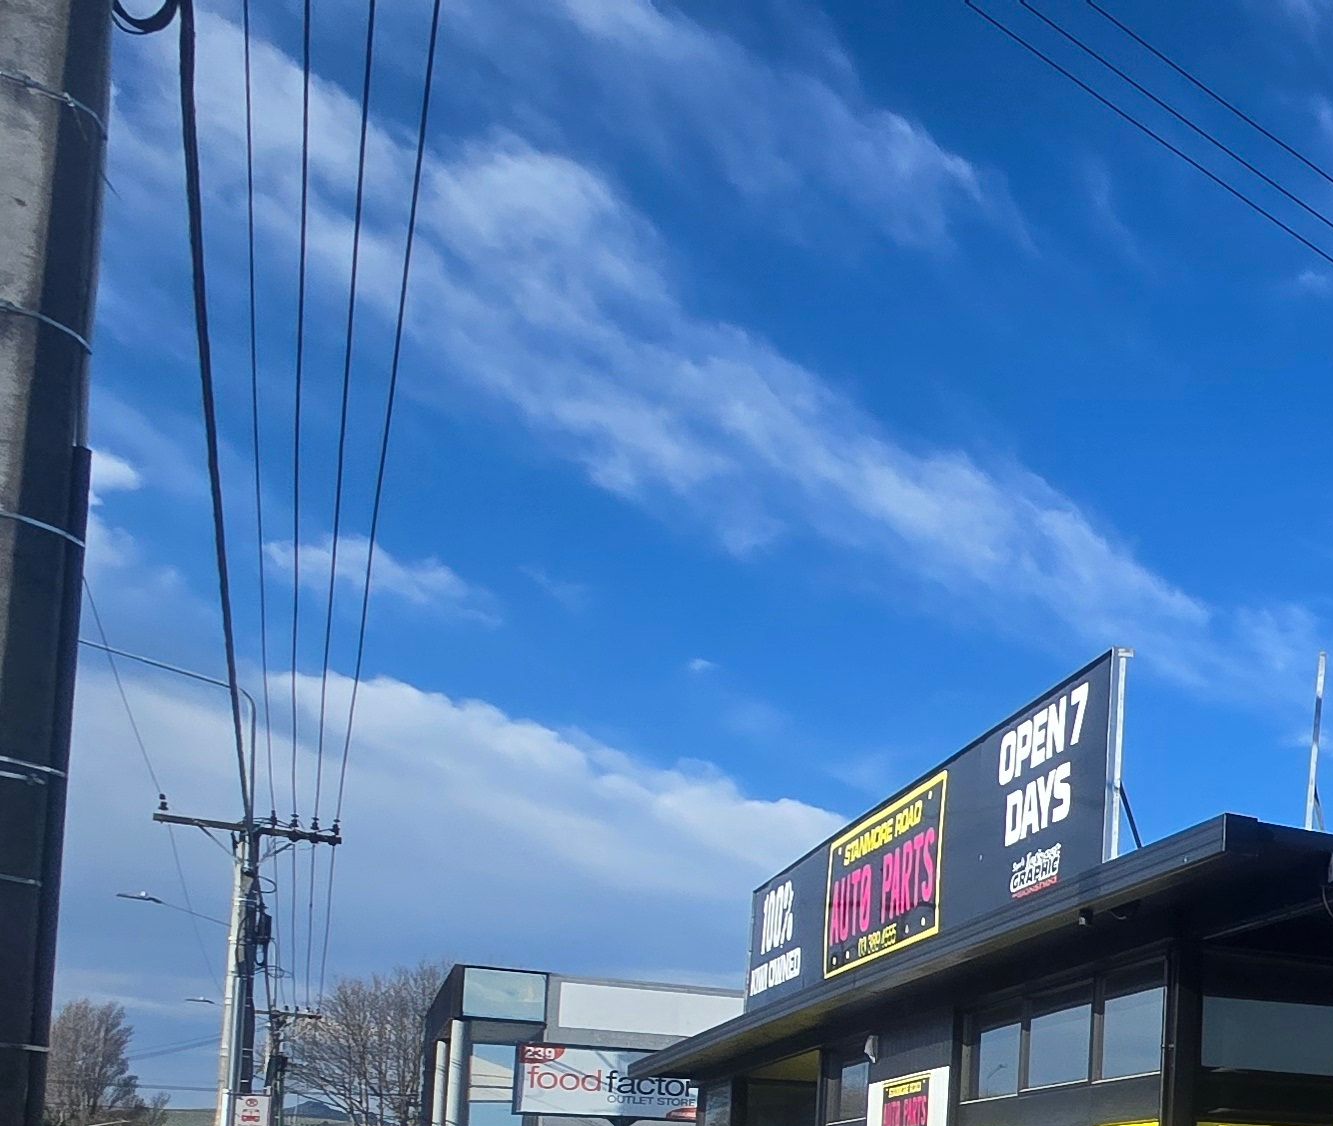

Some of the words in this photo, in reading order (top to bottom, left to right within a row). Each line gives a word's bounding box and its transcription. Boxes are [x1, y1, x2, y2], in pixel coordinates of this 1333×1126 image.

[998, 695, 1067, 786] OPEN
[1070, 681, 1090, 746] 7
[1004, 761, 1072, 847] DAYS
[843, 817, 894, 867] STANMORE
[894, 799, 923, 838] ROAD
[880, 826, 937, 924] PARTS
[1010, 855, 1060, 890] GRAPHIC
[760, 879, 795, 956] 100%
[768, 947, 801, 988] OWNED
[524, 1046, 556, 1061] 239
[526, 1065, 602, 1092] food
[605, 1069, 692, 1099] factor
[607, 1094, 653, 1106] OUTLET
[657, 1096, 697, 1108] STORE
